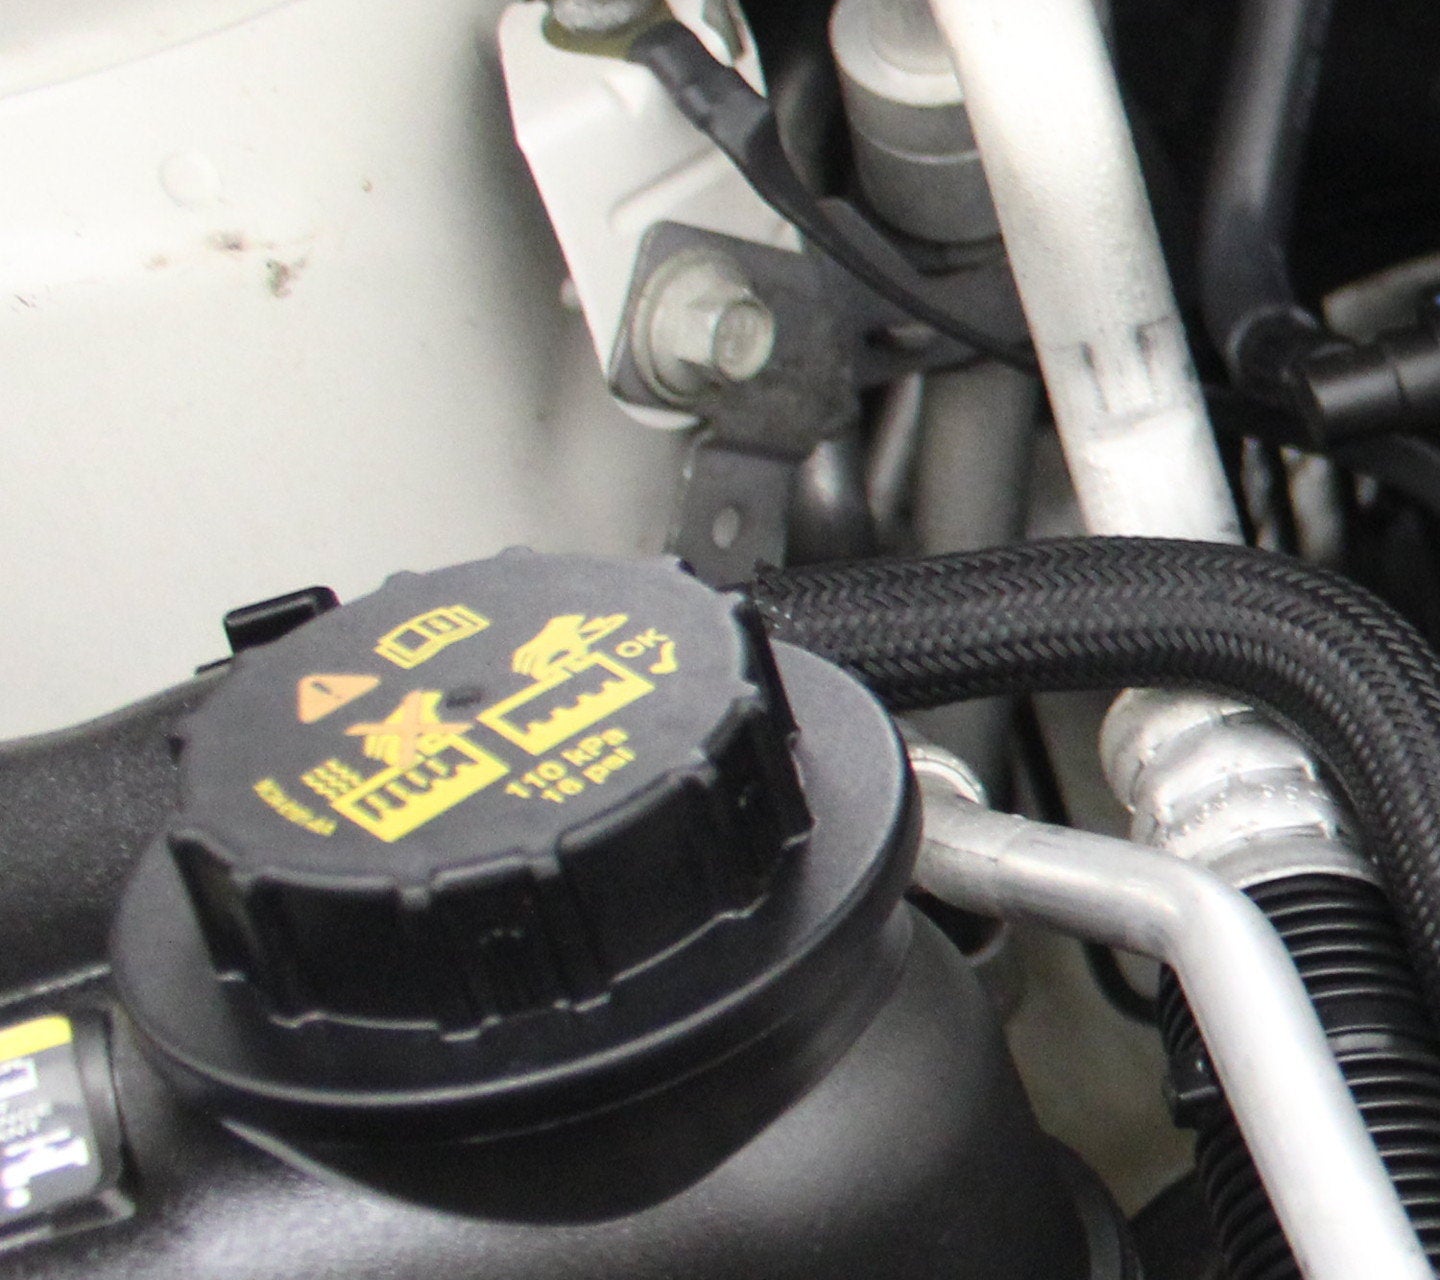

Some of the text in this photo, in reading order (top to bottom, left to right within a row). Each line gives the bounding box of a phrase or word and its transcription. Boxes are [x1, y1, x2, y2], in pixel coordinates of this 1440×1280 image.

[614, 628, 670, 658] OK
[504, 728, 629, 799] 110 kPa
[540, 776, 586, 804] 16
